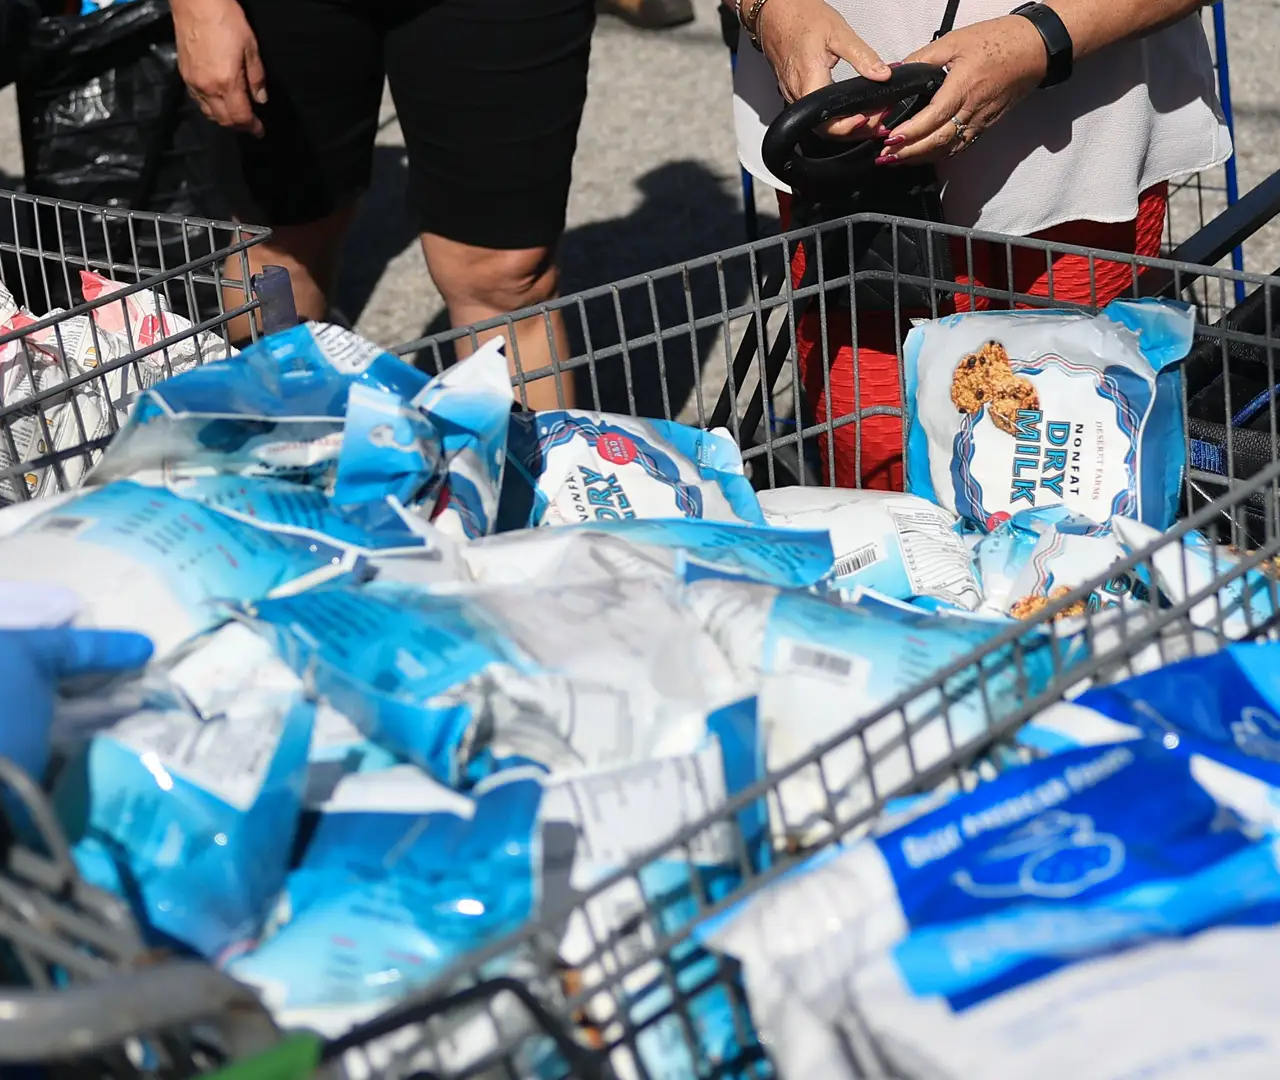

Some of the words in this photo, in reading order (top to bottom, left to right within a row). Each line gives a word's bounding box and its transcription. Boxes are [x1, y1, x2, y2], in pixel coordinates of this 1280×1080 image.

[577, 464, 620, 519] DRY
[1009, 408, 1044, 507] MILK
[1039, 420, 1072, 499] DRY
[1069, 423, 1085, 496] NONFAT
[1091, 468, 1104, 501] FARMS
